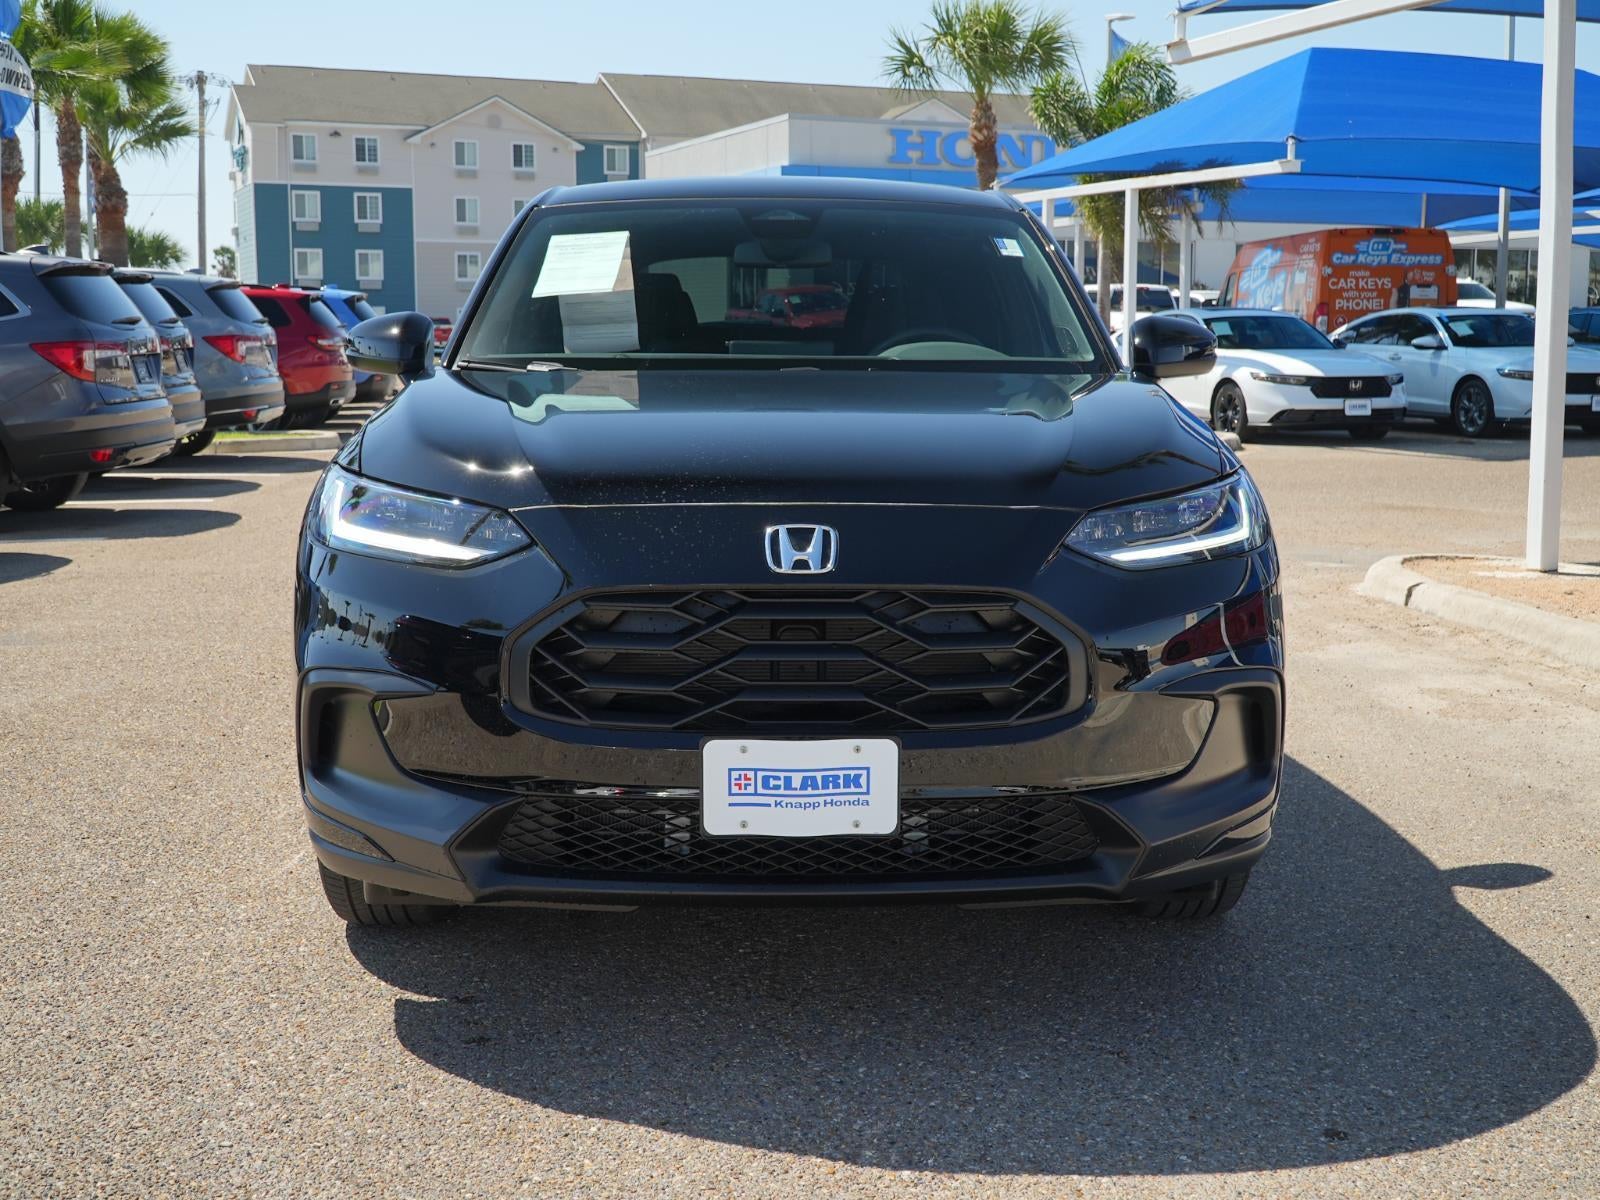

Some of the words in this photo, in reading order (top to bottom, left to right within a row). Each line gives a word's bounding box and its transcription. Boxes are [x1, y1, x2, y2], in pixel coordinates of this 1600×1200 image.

[888, 128, 1057, 168] HOND
[1332, 253, 1354, 264] Car
[1357, 253, 1388, 266] Keys
[1390, 253, 1443, 266] Express
[1328, 278, 1356, 290] CAR
[1358, 278, 1392, 290] KEYS
[1342, 290, 1359, 298] with
[1360, 291, 1377, 299] your
[1335, 299, 1384, 311] PHONE!
[761, 773, 864, 791] CLARK
[774, 799, 821, 811] Knapp
[823, 797, 870, 808] Honda
